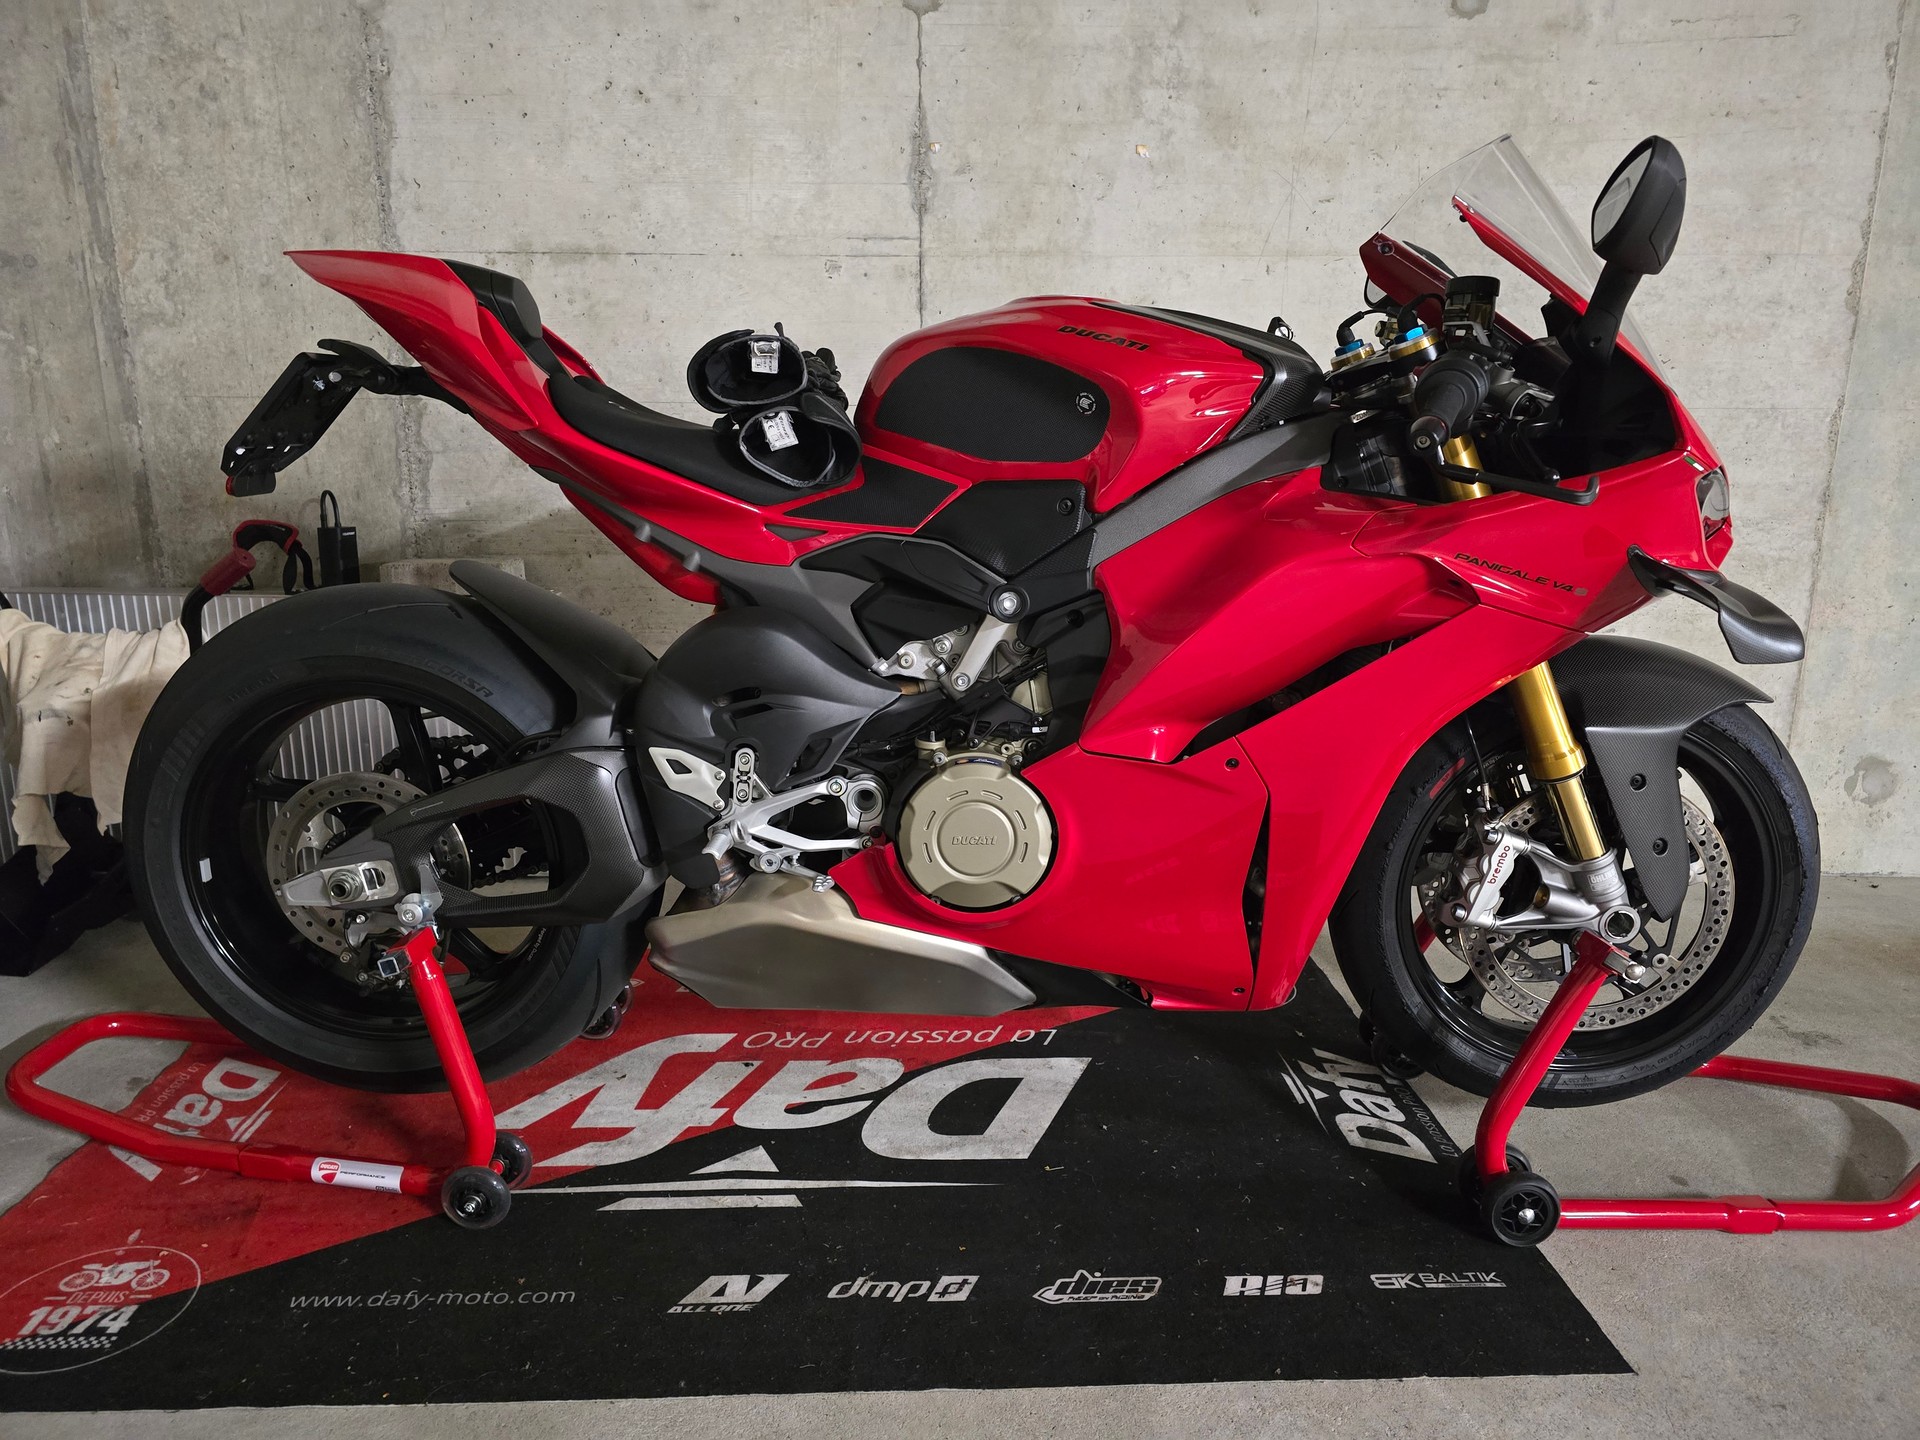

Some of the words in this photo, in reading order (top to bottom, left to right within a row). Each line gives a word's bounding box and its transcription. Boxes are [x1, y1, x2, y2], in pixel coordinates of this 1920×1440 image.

[1057, 326, 1150, 351] DUCATI
[1454, 553, 1550, 586] PANIGALE
[952, 836, 996, 846] DUCATI
[1487, 846, 1511, 885] brembo
[743, 1031, 832, 1049] PRO
[844, 1025, 1003, 1048] passion
[1011, 1028, 1057, 1046] La
[151, 1071, 190, 1108] passion
[495, 1033, 1092, 1167] Dafy
[134, 1110, 156, 1122] PR
[1413, 1106, 1453, 1149] passion
[340, 1170, 385, 1179] PERFORMANCE
[1418, 1271, 1502, 1284] BALTIK
[66, 1291, 129, 1304] DEPUIS
[290, 1289, 576, 1310] www.dafy-moto.com
[667, 1304, 709, 1313] ALL
[710, 1303, 757, 1312] ONE
[17, 1305, 140, 1335] 1974
